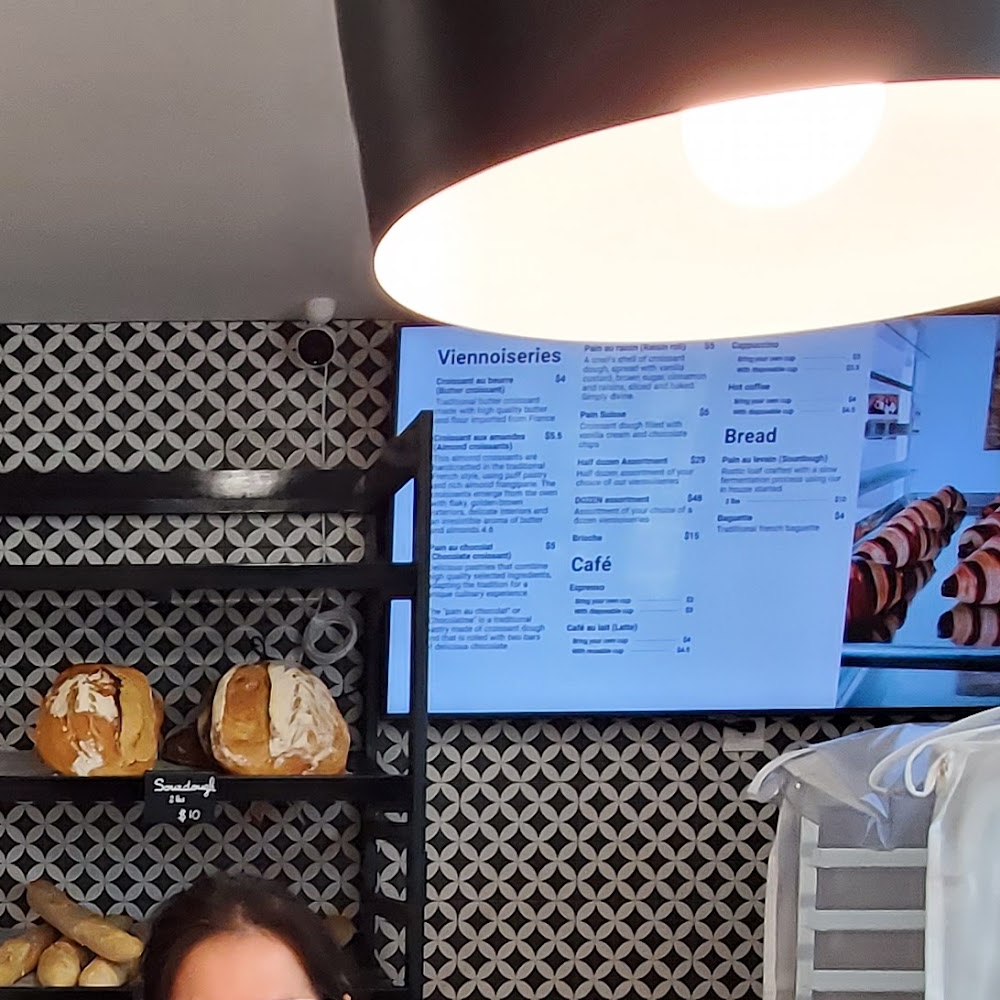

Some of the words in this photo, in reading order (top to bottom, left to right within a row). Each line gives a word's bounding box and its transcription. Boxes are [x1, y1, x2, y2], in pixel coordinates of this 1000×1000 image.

[437, 347, 562, 365] Viennoiseries
[725, 427, 777, 444] Bread
[571, 555, 612, 572] Café
